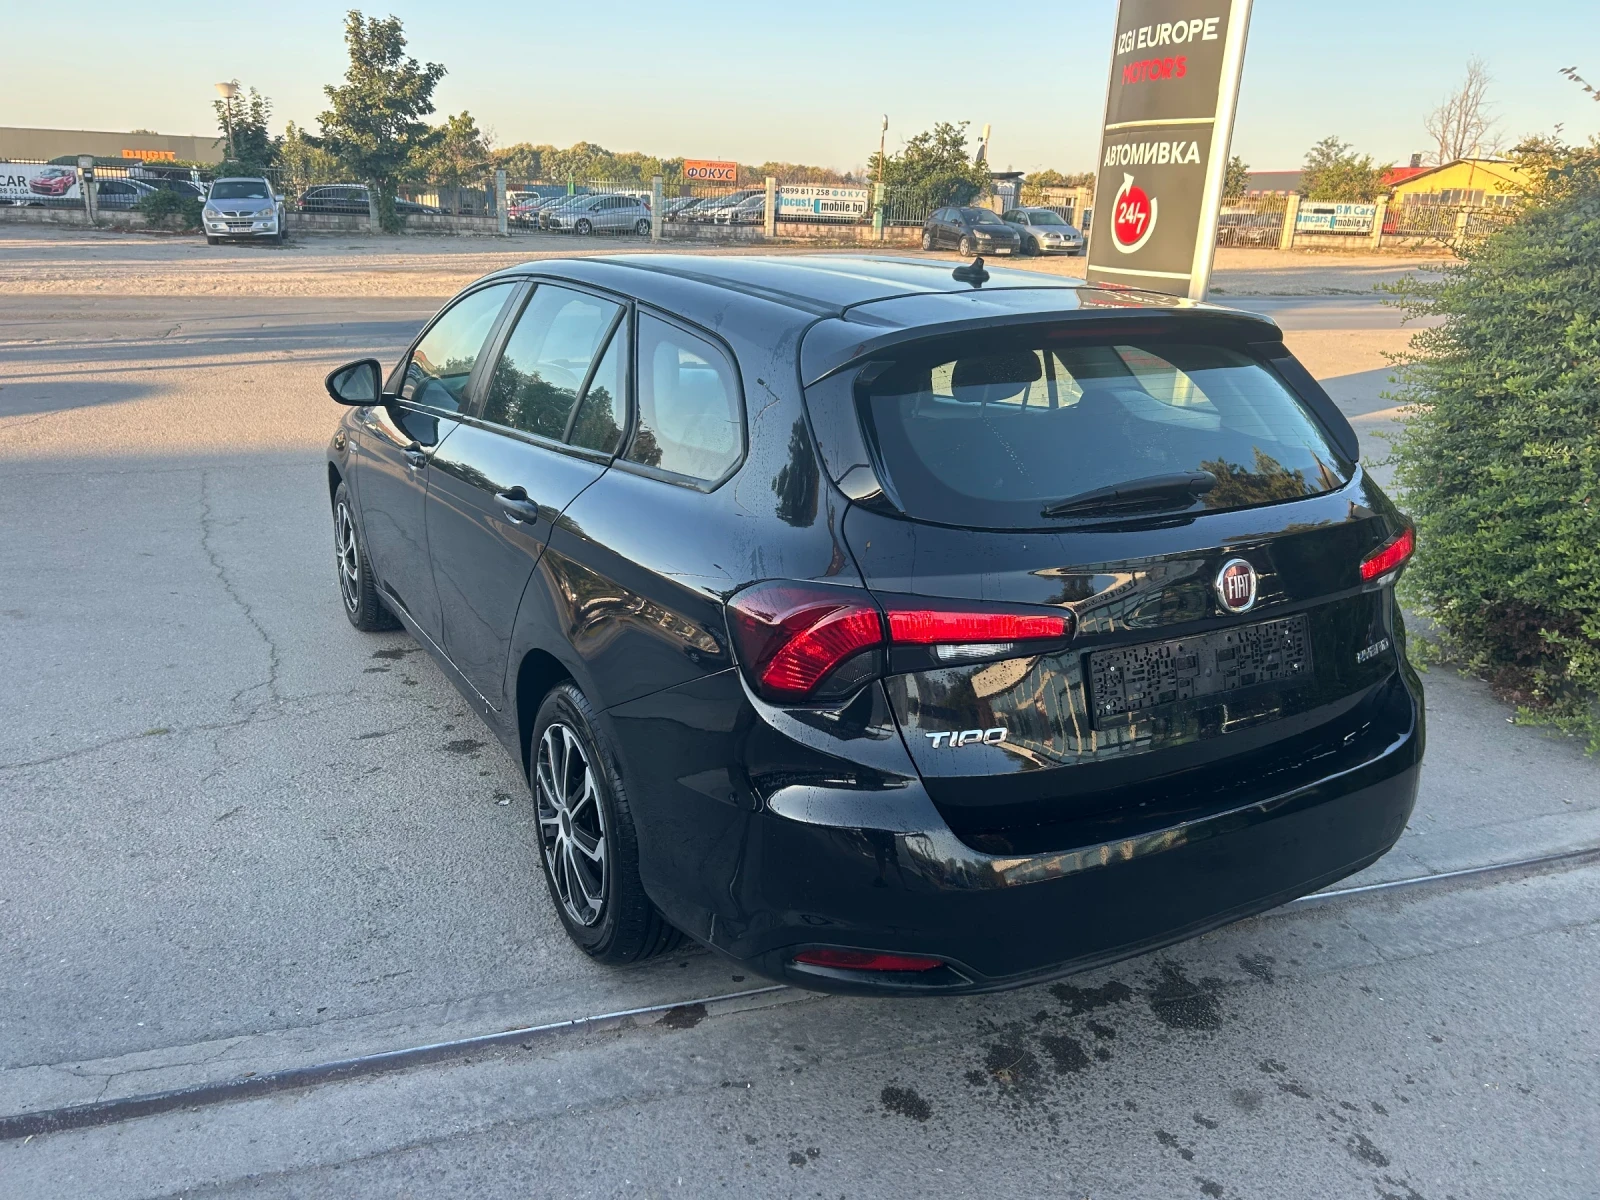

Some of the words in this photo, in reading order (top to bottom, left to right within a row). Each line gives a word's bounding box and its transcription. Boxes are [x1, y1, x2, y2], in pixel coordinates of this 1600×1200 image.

[1117, 29, 1136, 55] IZGI
[1137, 17, 1220, 49] EUROPE
[1121, 55, 1187, 85] MOTOR'S
[1104, 141, 1200, 167] АВТОМИВКА
[687, 167, 734, 179] ФОКУС
[821, 201, 863, 213] mobile.bg
[832, 190, 867, 198] ФОКУС
[1118, 202, 1146, 234] 24/7
[1227, 573, 1249, 600] FIAT
[925, 727, 1008, 749] TIPO
